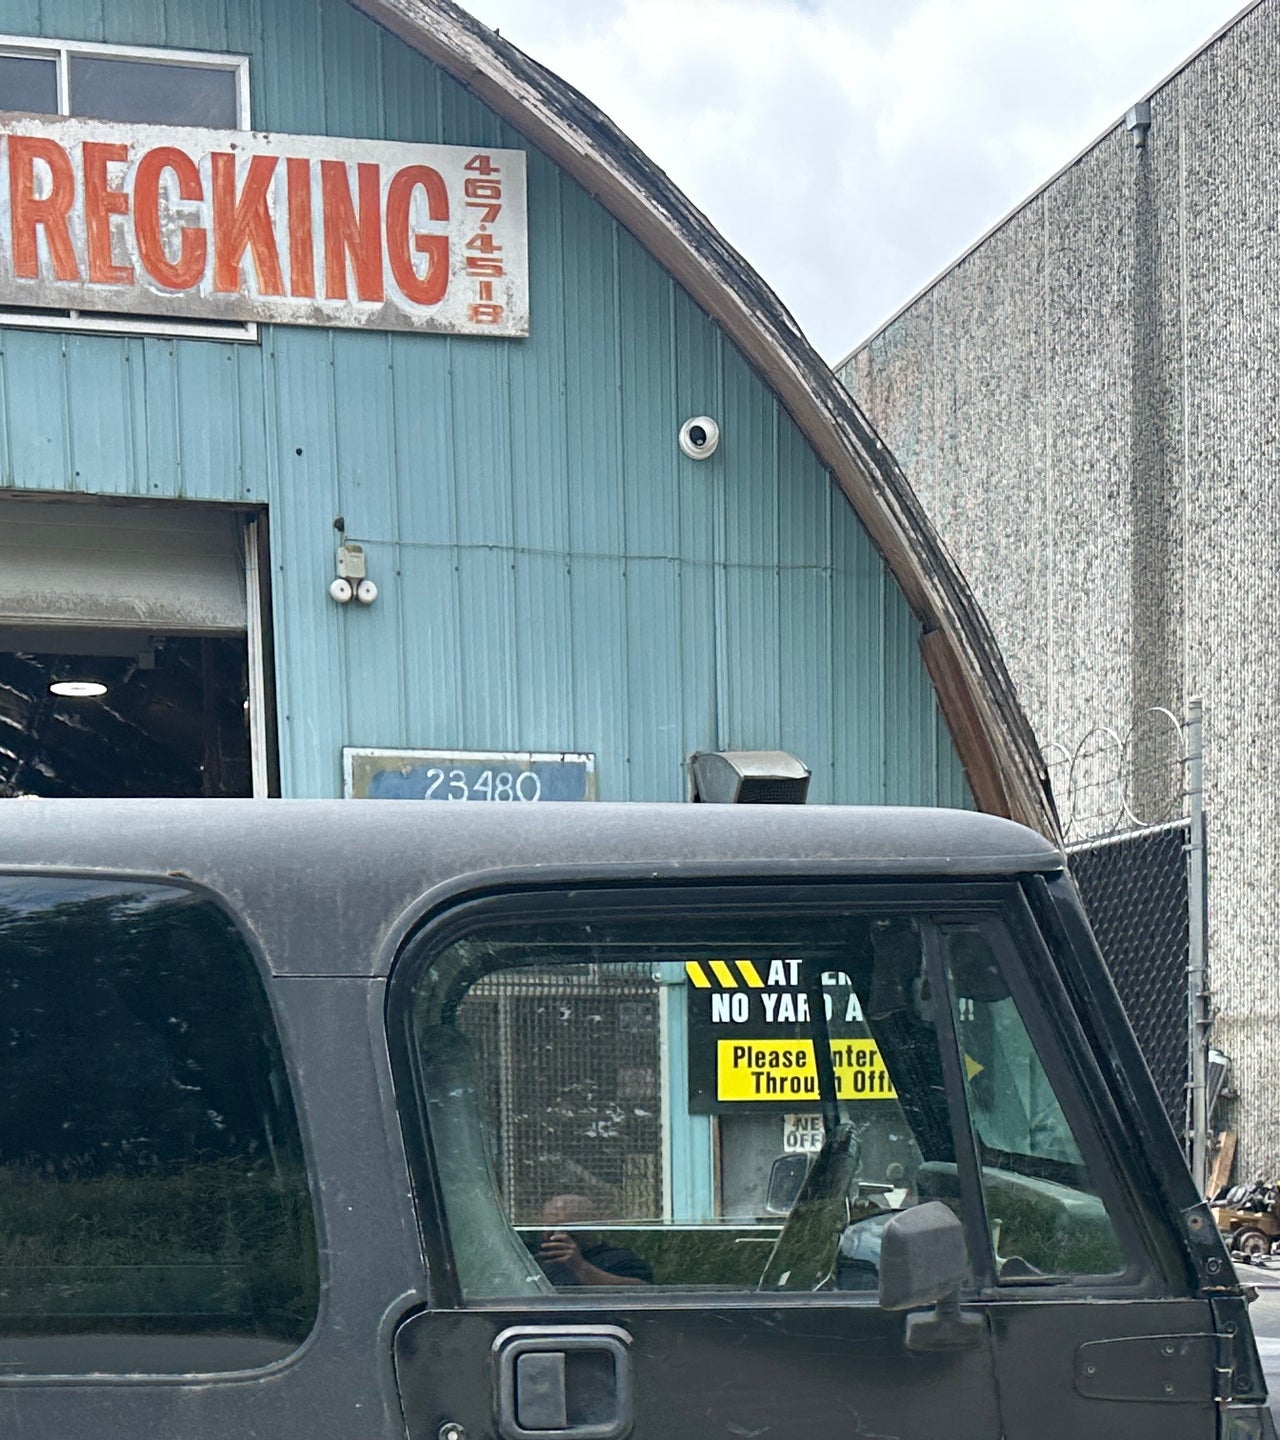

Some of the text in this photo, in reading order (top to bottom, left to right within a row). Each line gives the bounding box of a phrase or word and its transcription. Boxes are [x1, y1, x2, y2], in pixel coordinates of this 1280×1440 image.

[425, 768, 542, 801] 23480
[711, 992, 749, 1022] NO
[733, 1045, 877, 1068] Please nter
